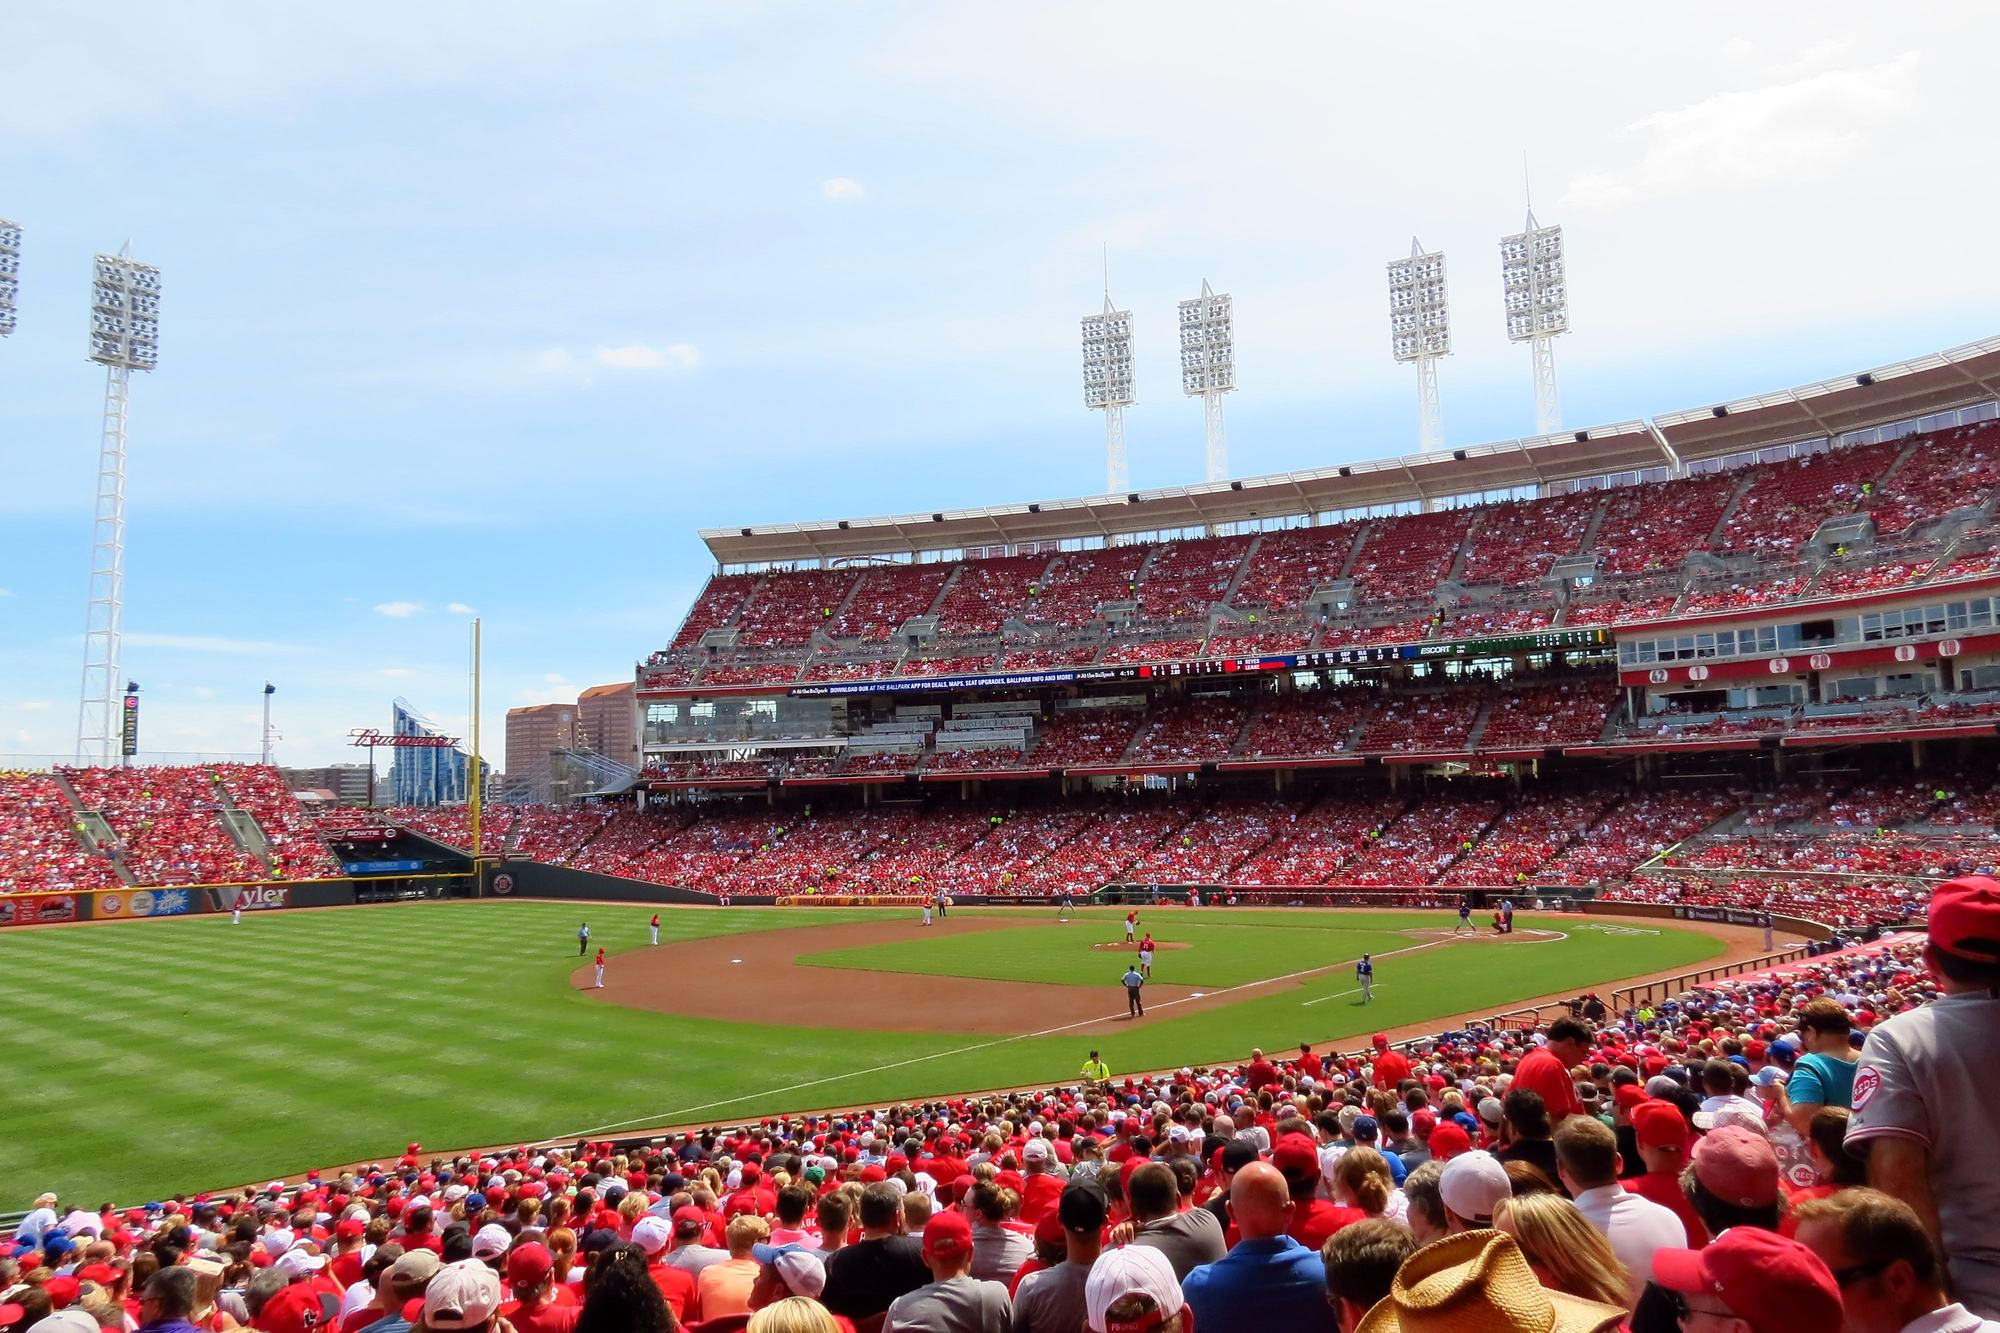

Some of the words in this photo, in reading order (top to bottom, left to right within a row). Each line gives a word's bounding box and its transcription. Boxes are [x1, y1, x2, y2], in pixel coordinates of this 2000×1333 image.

[1420, 645, 1451, 655] ESCORT
[1775, 660, 1784, 671] 5
[1119, 669, 1135, 677] 4:10
[1651, 671, 1665, 682] 42
[978, 677, 1006, 685] UPGRADES,
[1006, 676, 1031, 684] BALLPARK
[207, 886, 288, 911] Wyler
[879, 897, 906, 905] GORILLA
[1853, 1075, 1878, 1097] REDS
